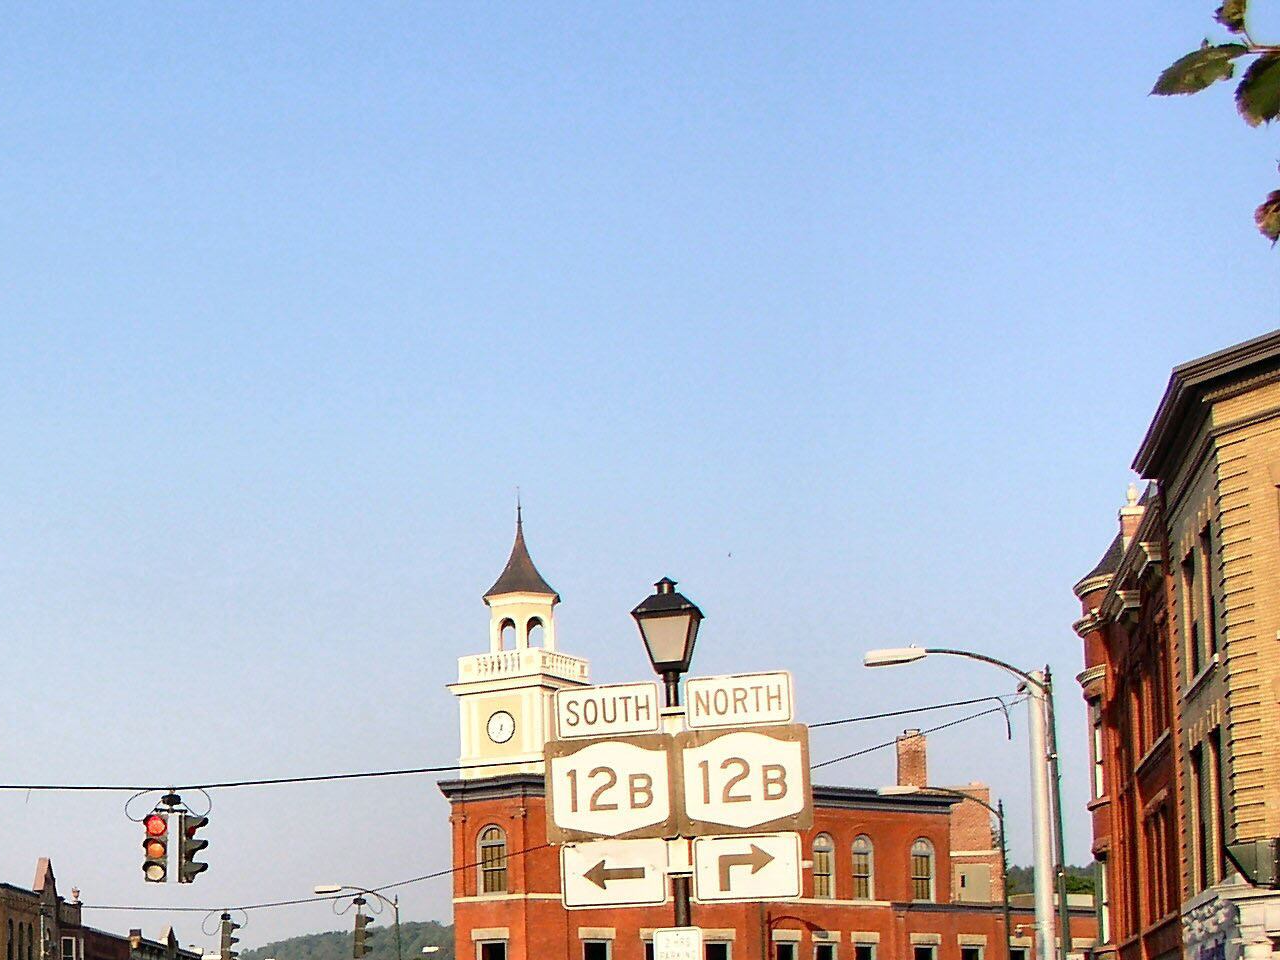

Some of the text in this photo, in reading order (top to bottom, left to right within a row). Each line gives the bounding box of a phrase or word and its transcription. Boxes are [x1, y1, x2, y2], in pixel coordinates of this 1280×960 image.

[566, 694, 651, 727] SOUTH
[694, 683, 782, 716] NORTH
[566, 766, 654, 813] 12B
[697, 757, 788, 805] 12B
